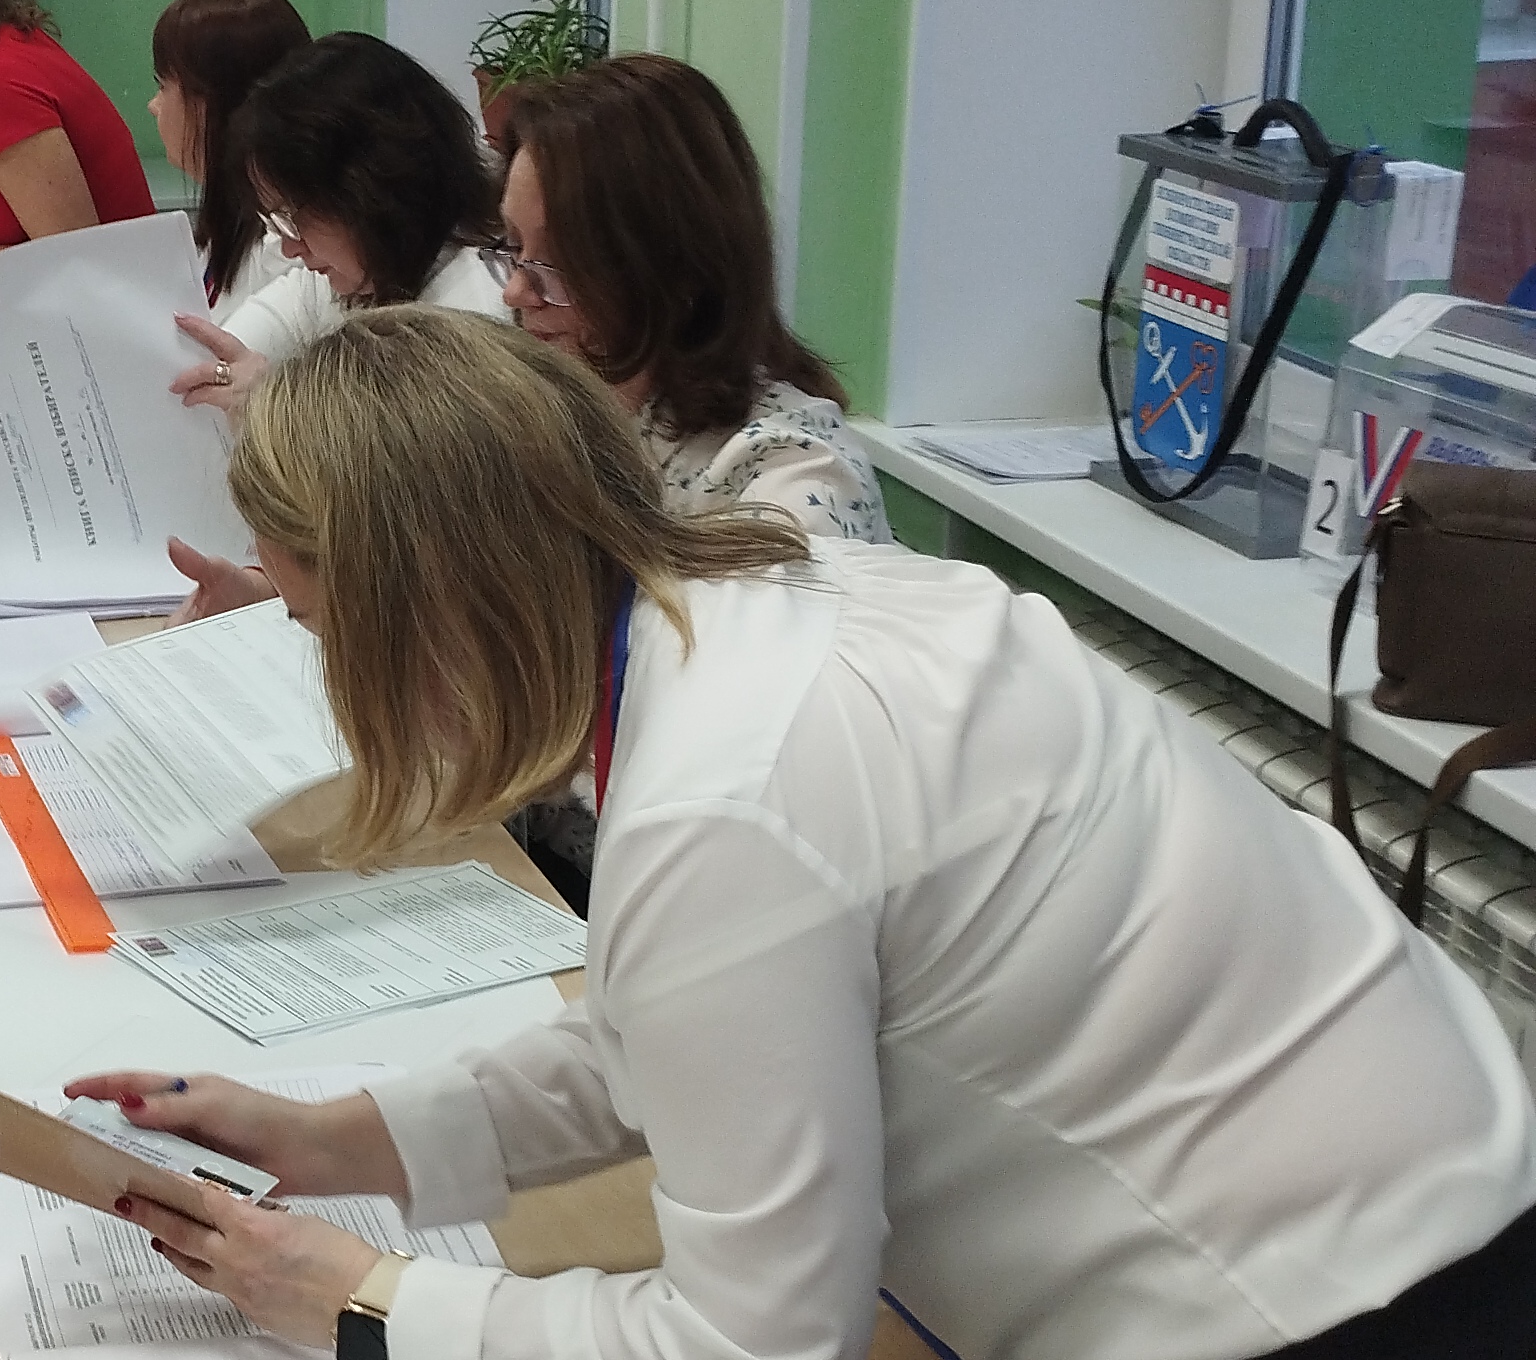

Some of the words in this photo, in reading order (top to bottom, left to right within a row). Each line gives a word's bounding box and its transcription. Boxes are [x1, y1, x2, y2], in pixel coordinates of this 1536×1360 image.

[25, 340, 67, 439] ИЗБИРАТЕЛЕЙ
[60, 439, 84, 496] СПИСКА
[77, 498, 97, 546] КНИГА
[1315, 478, 1339, 536] 2
